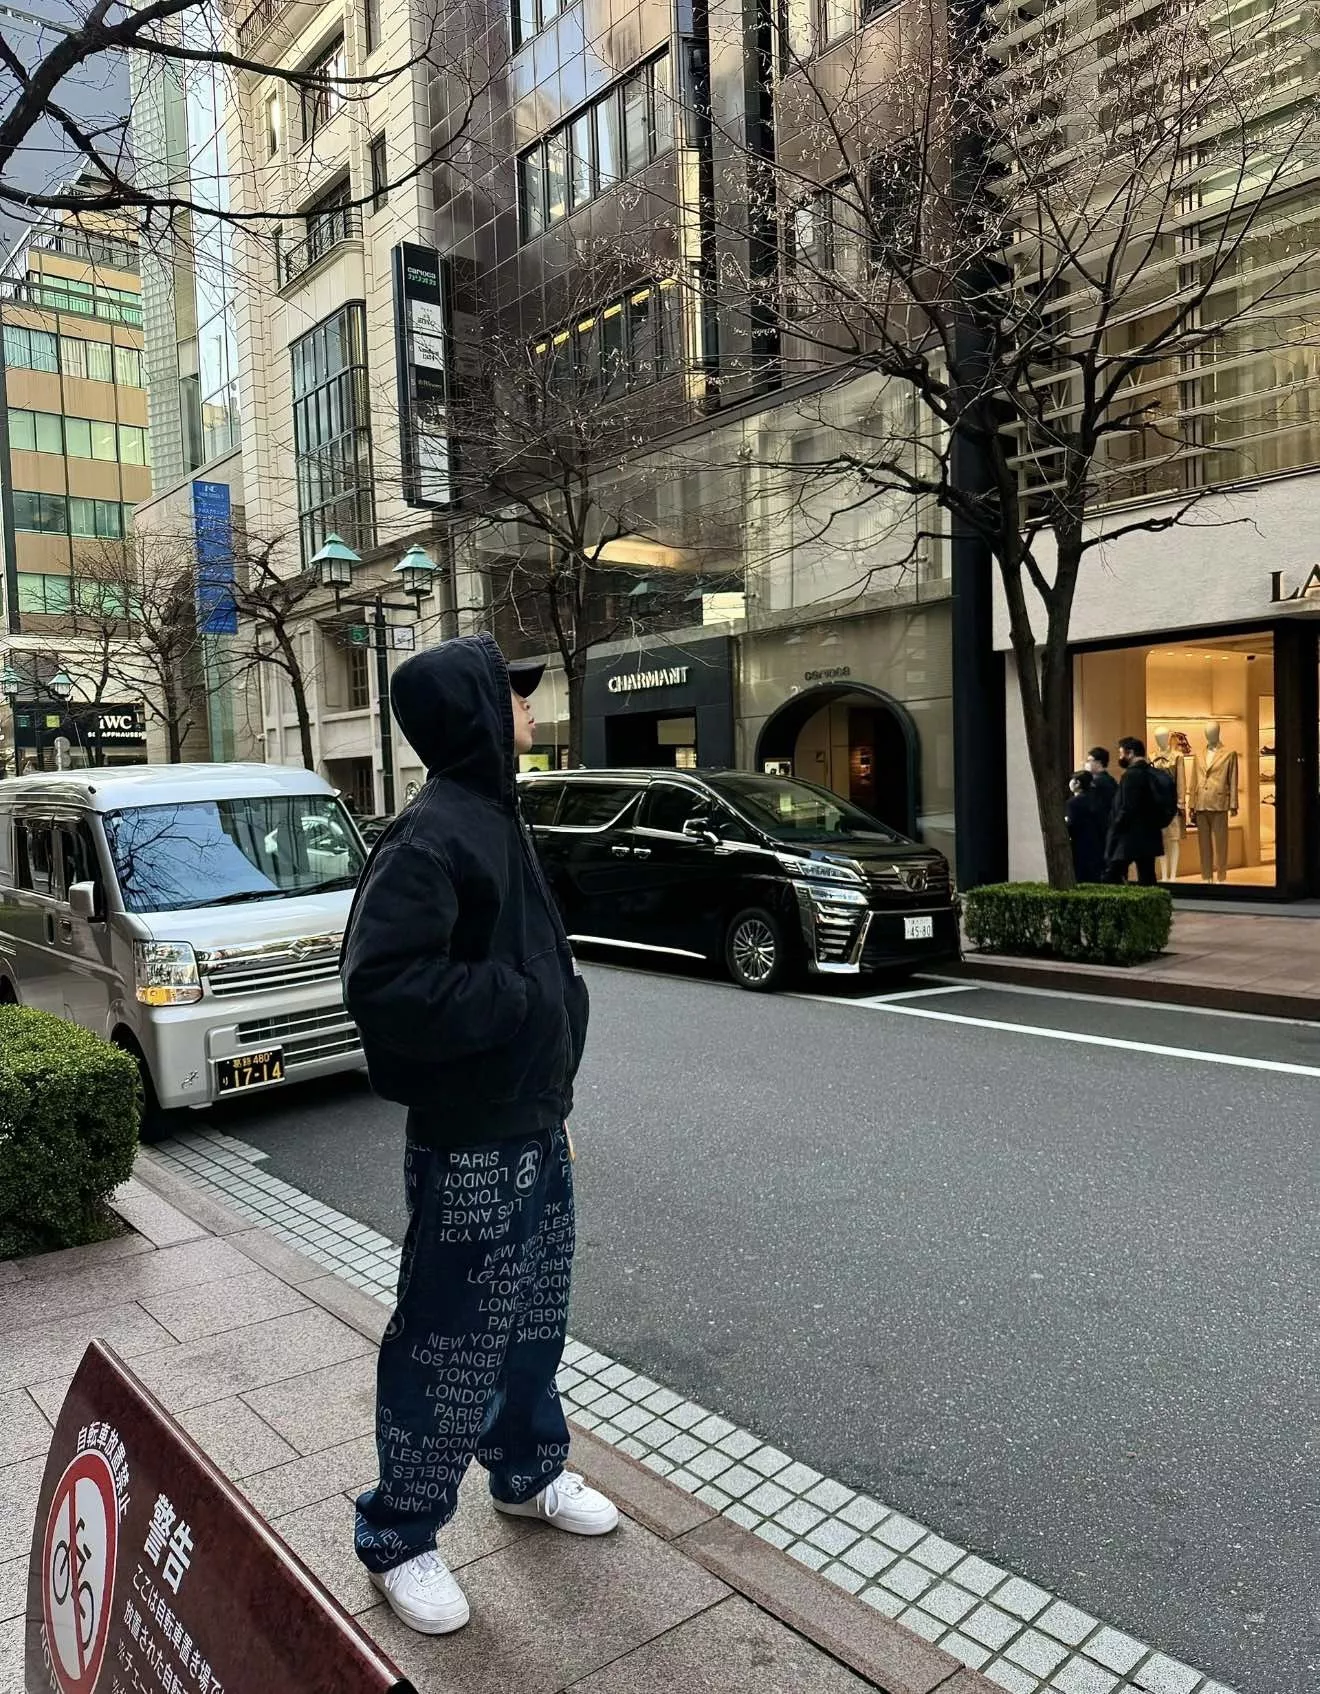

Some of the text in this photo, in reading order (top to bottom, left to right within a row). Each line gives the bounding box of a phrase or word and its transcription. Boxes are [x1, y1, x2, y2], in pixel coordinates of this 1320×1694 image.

[1269, 564, 1320, 603] LA
[608, 667, 689, 692] CHARMANT
[98, 715, 132, 729] IWC
[88, 731, 146, 740] SCAFFHAUSEN
[253, 1053, 270, 1064] 480
[235, 1061, 282, 1088] 17-14
[450, 1151, 499, 1168] PARIS
[428, 1332, 509, 1350] NEW YOR
[516, 1325, 560, 1343] YORK
[411, 1344, 444, 1367] LOS
[437, 1367, 495, 1386] TOKYO
[433, 1402, 484, 1421] PARIS
[77, 1421, 131, 1523] 自転車放置禁止
[403, 1481, 448, 1503] YORK
[144, 1493, 194, 1595] 警告
[124, 1599, 188, 1694] 放置された自転
